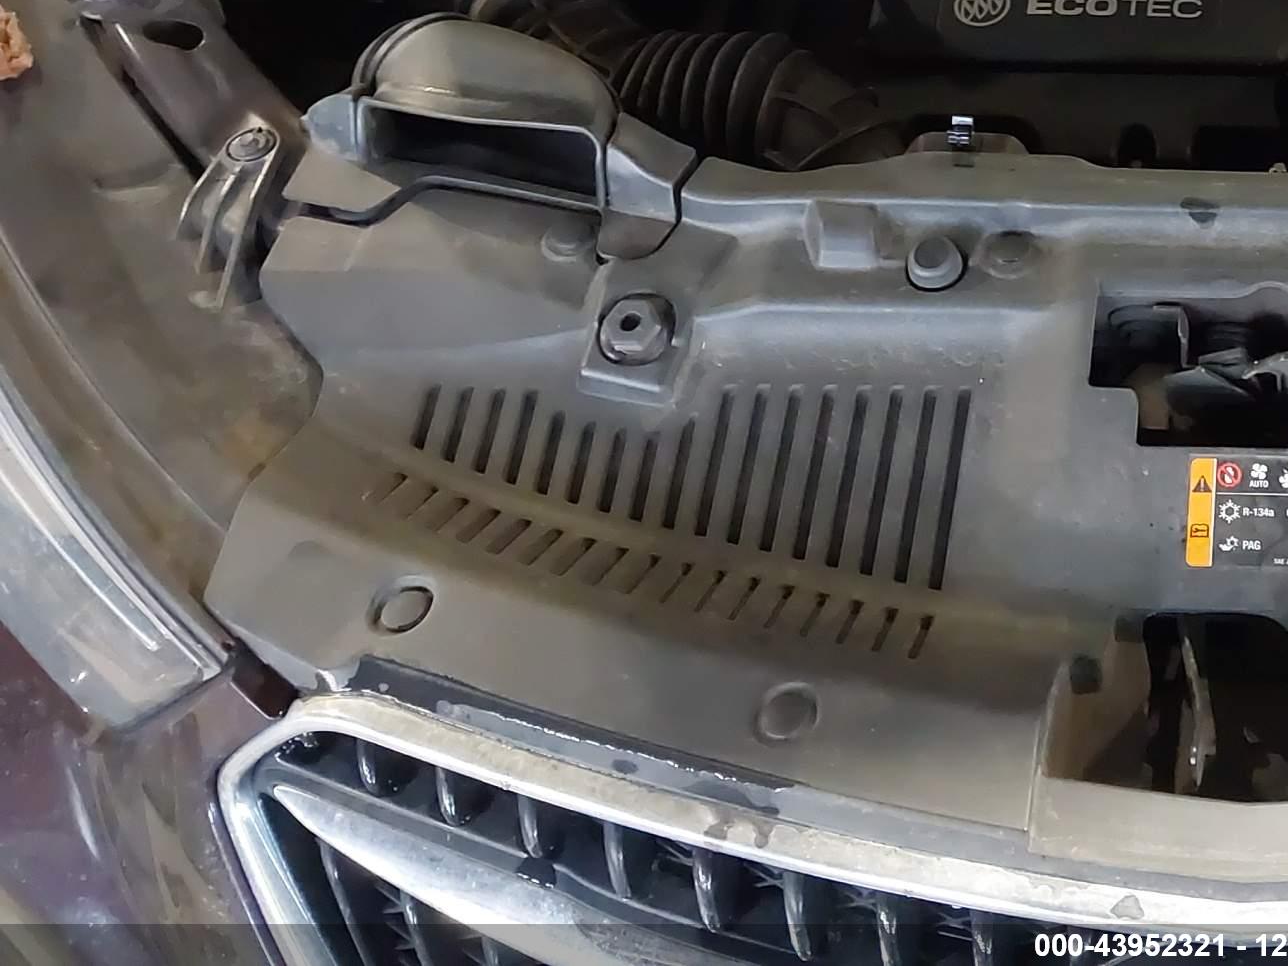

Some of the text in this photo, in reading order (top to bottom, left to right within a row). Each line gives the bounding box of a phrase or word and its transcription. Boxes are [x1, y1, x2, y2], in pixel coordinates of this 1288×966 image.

[1249, 480, 1269, 488] AUTO
[1243, 507, 1275, 517] R-134a
[1242, 540, 1261, 550] PAG
